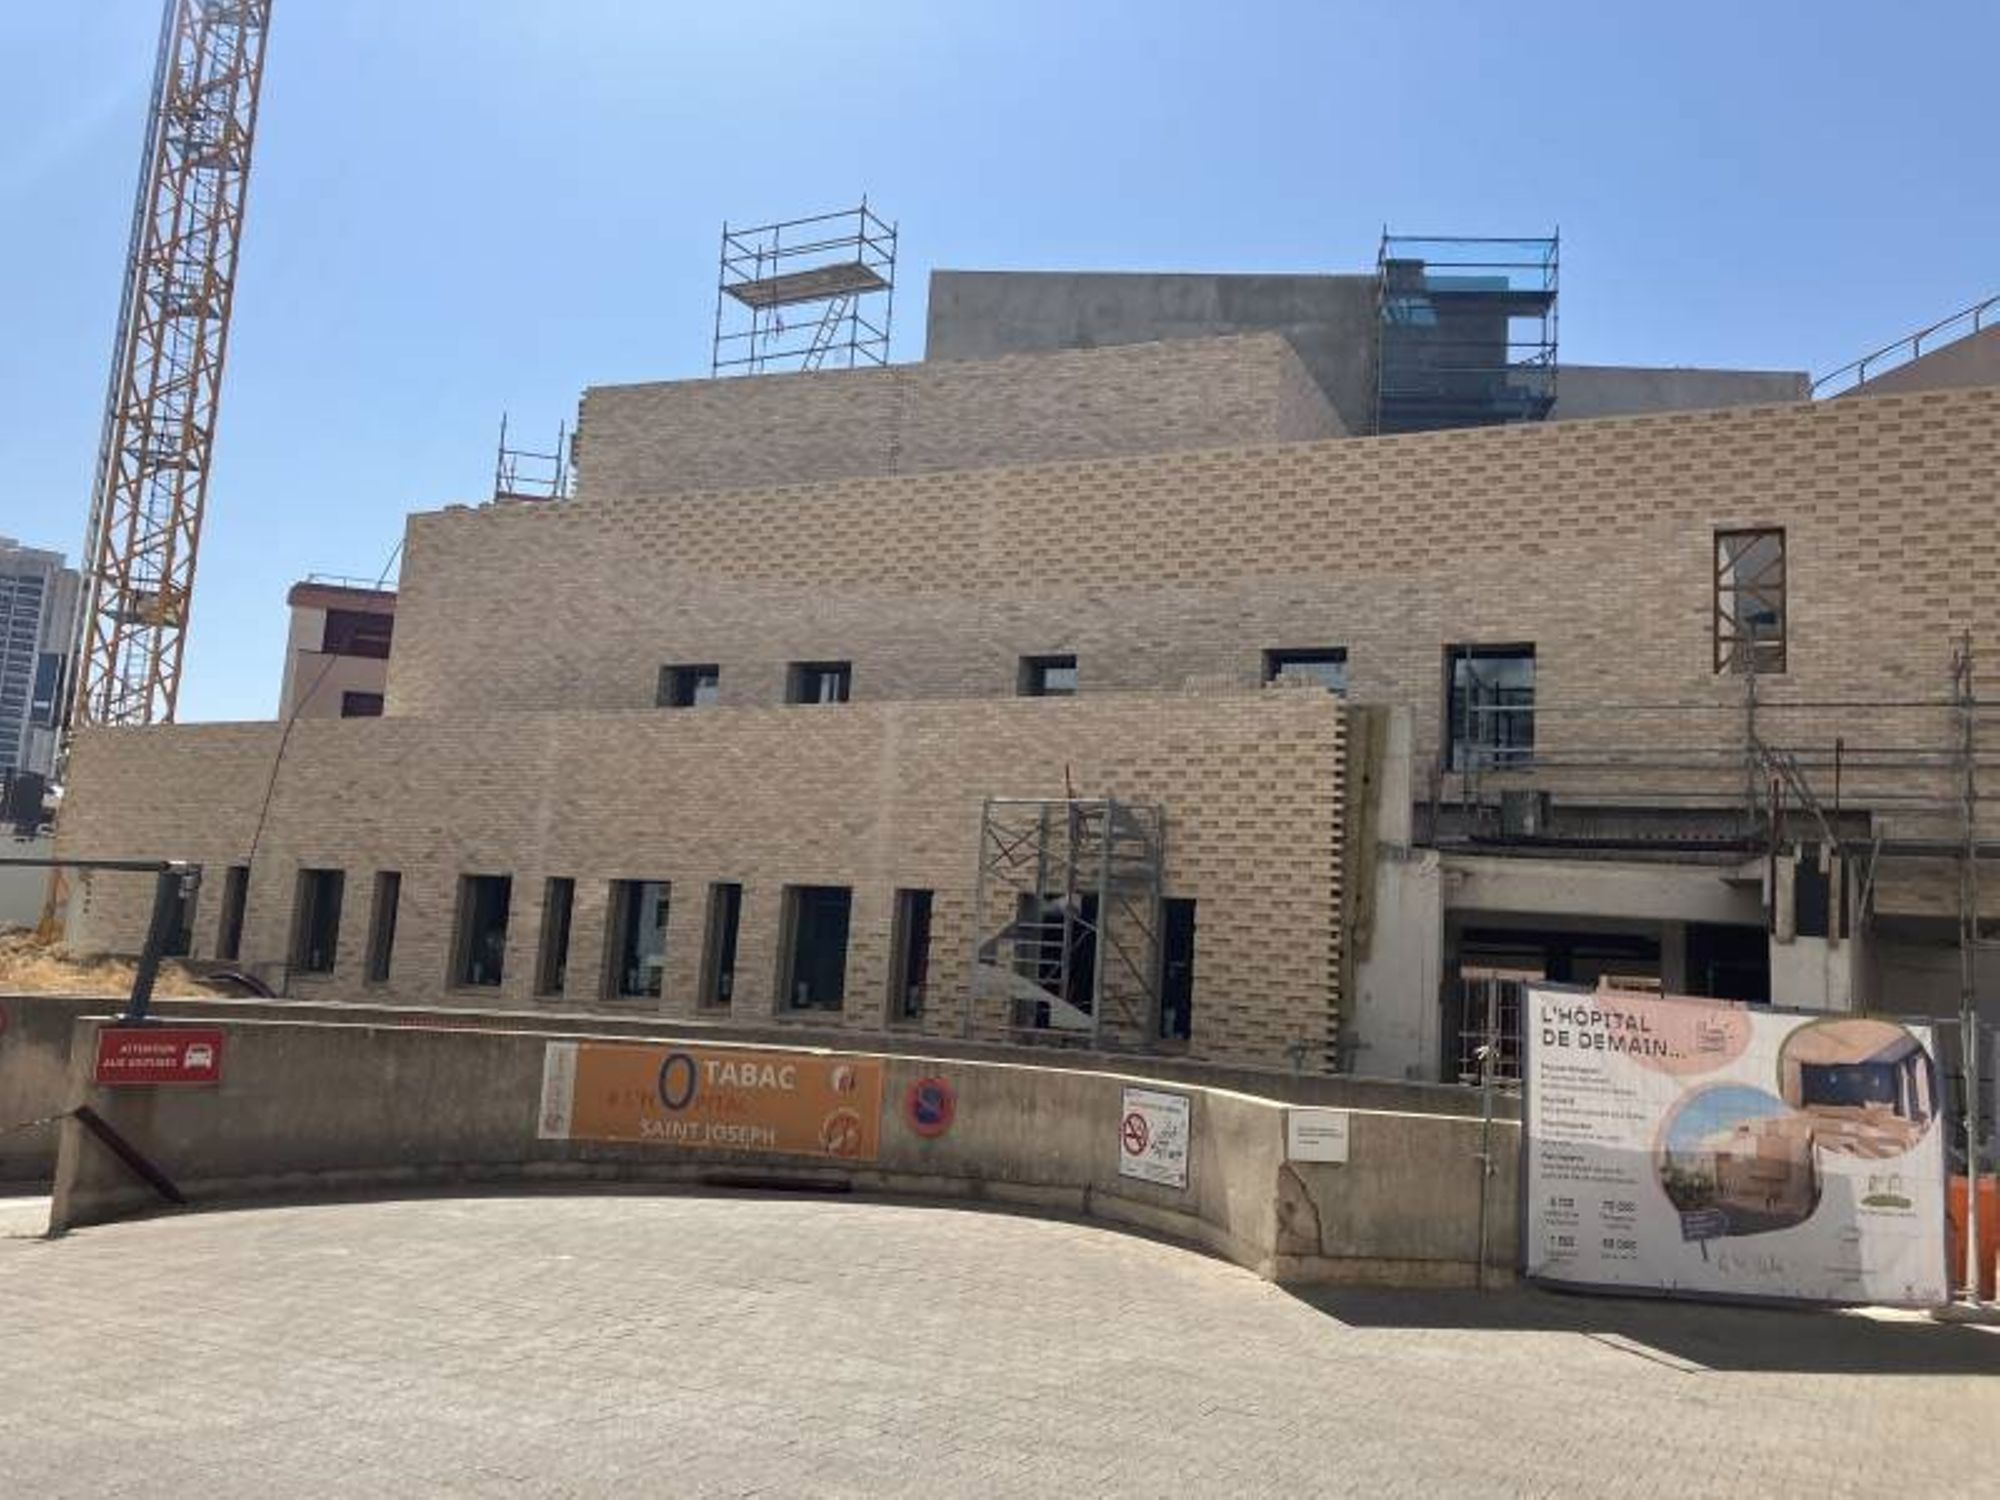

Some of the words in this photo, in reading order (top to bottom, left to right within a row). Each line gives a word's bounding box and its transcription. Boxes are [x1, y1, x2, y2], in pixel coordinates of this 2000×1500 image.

[1541, 1005, 1652, 1032] L'HÔPITAL
[1542, 1028, 1570, 1047] DE
[1578, 1032, 1687, 1060] DEMAIN...
[705, 1059, 797, 1090] TABAC
[640, 1117, 699, 1141] SAINT
[704, 1120, 776, 1147] JOSEPH
